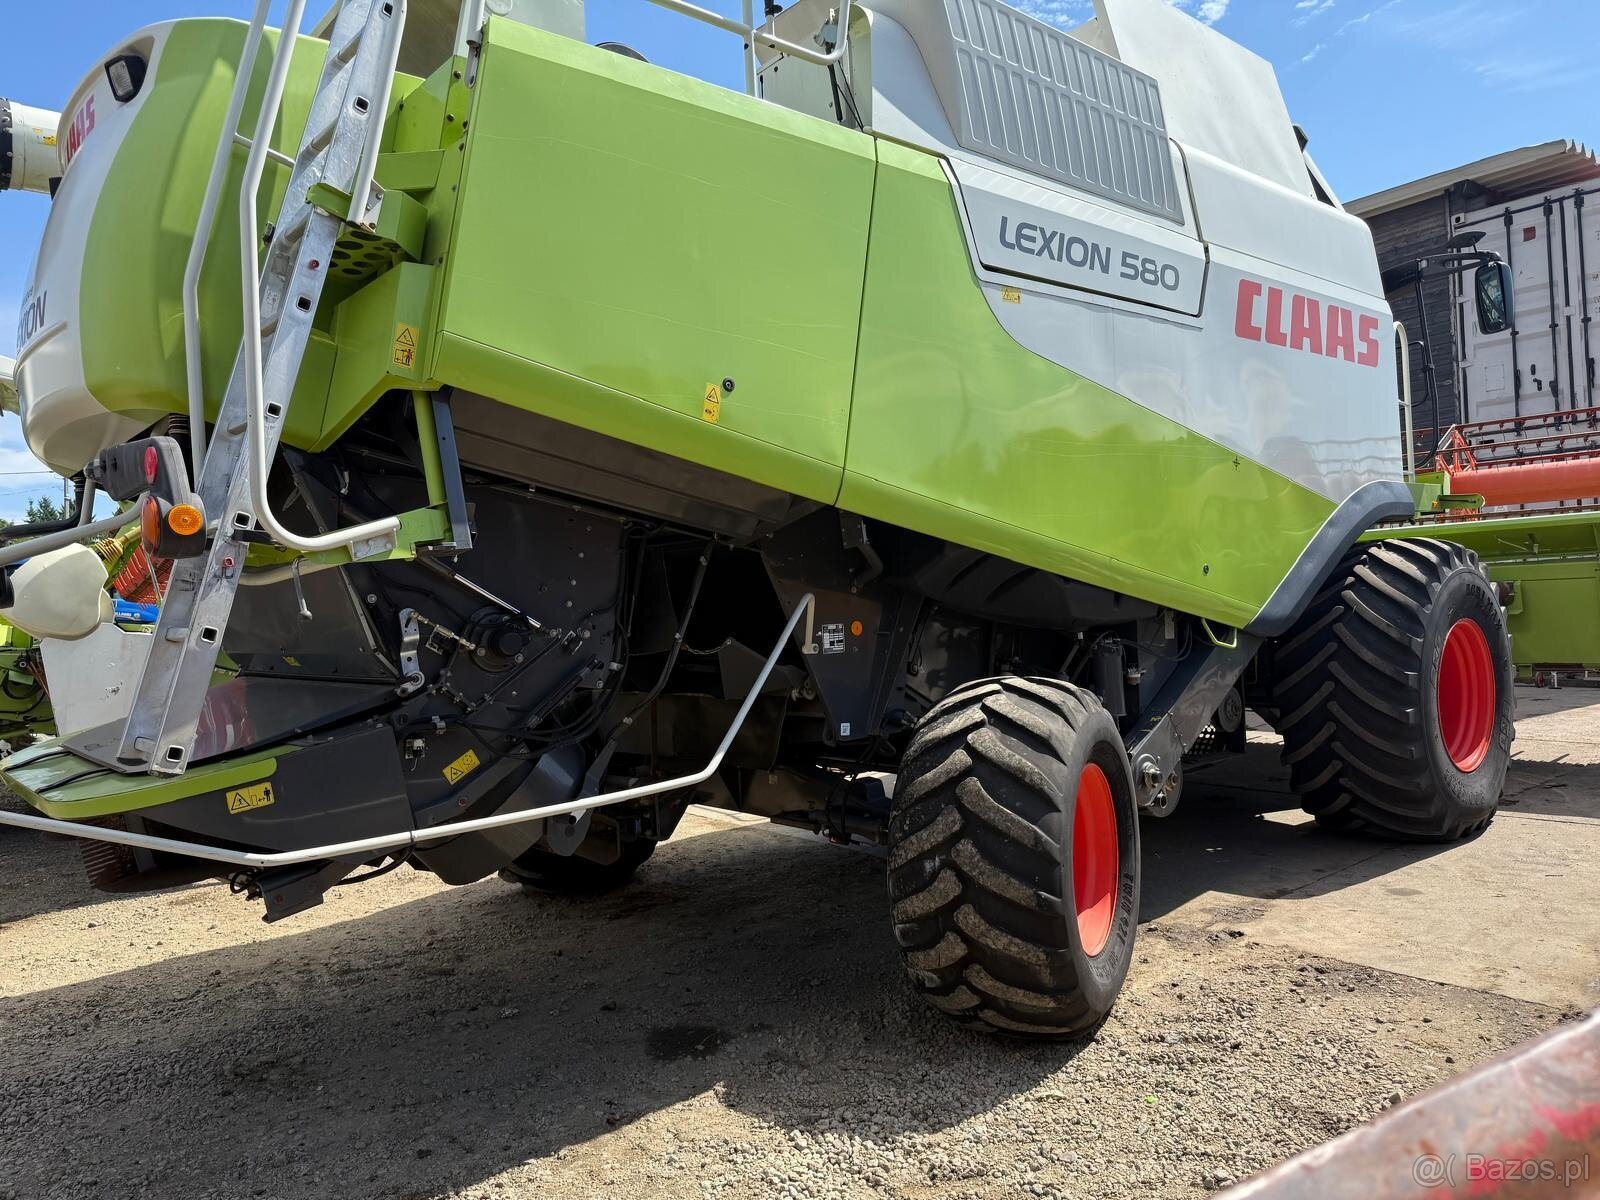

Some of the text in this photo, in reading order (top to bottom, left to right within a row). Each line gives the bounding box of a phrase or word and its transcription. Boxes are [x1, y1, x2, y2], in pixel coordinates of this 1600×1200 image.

[1000, 215, 1180, 291] LEXION 580
[1235, 278, 1379, 367] CLAAS
